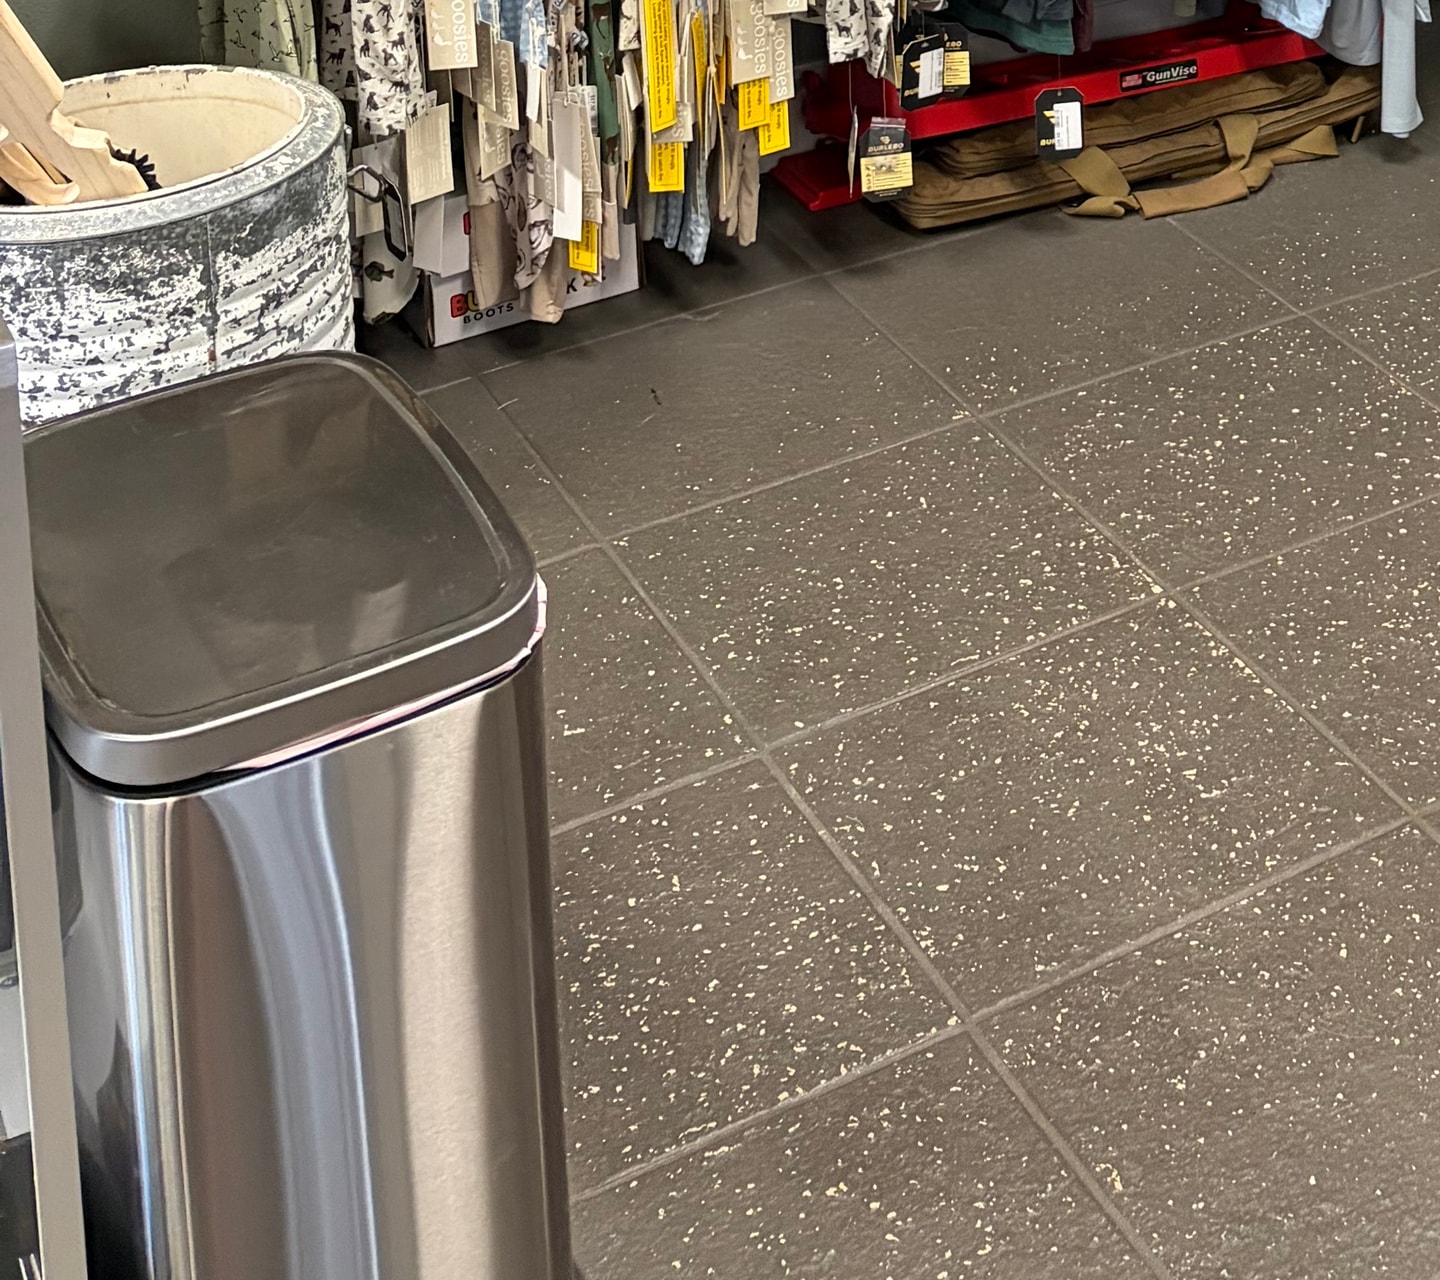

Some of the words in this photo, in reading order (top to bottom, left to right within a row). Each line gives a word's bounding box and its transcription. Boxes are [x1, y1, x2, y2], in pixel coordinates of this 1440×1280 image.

[749, 3, 767, 75] goosies
[771, 27, 788, 99] goosies
[1145, 64, 1198, 83] GunVise
[498, 48, 514, 124] goosies
[463, 302, 515, 325] BOOTS
